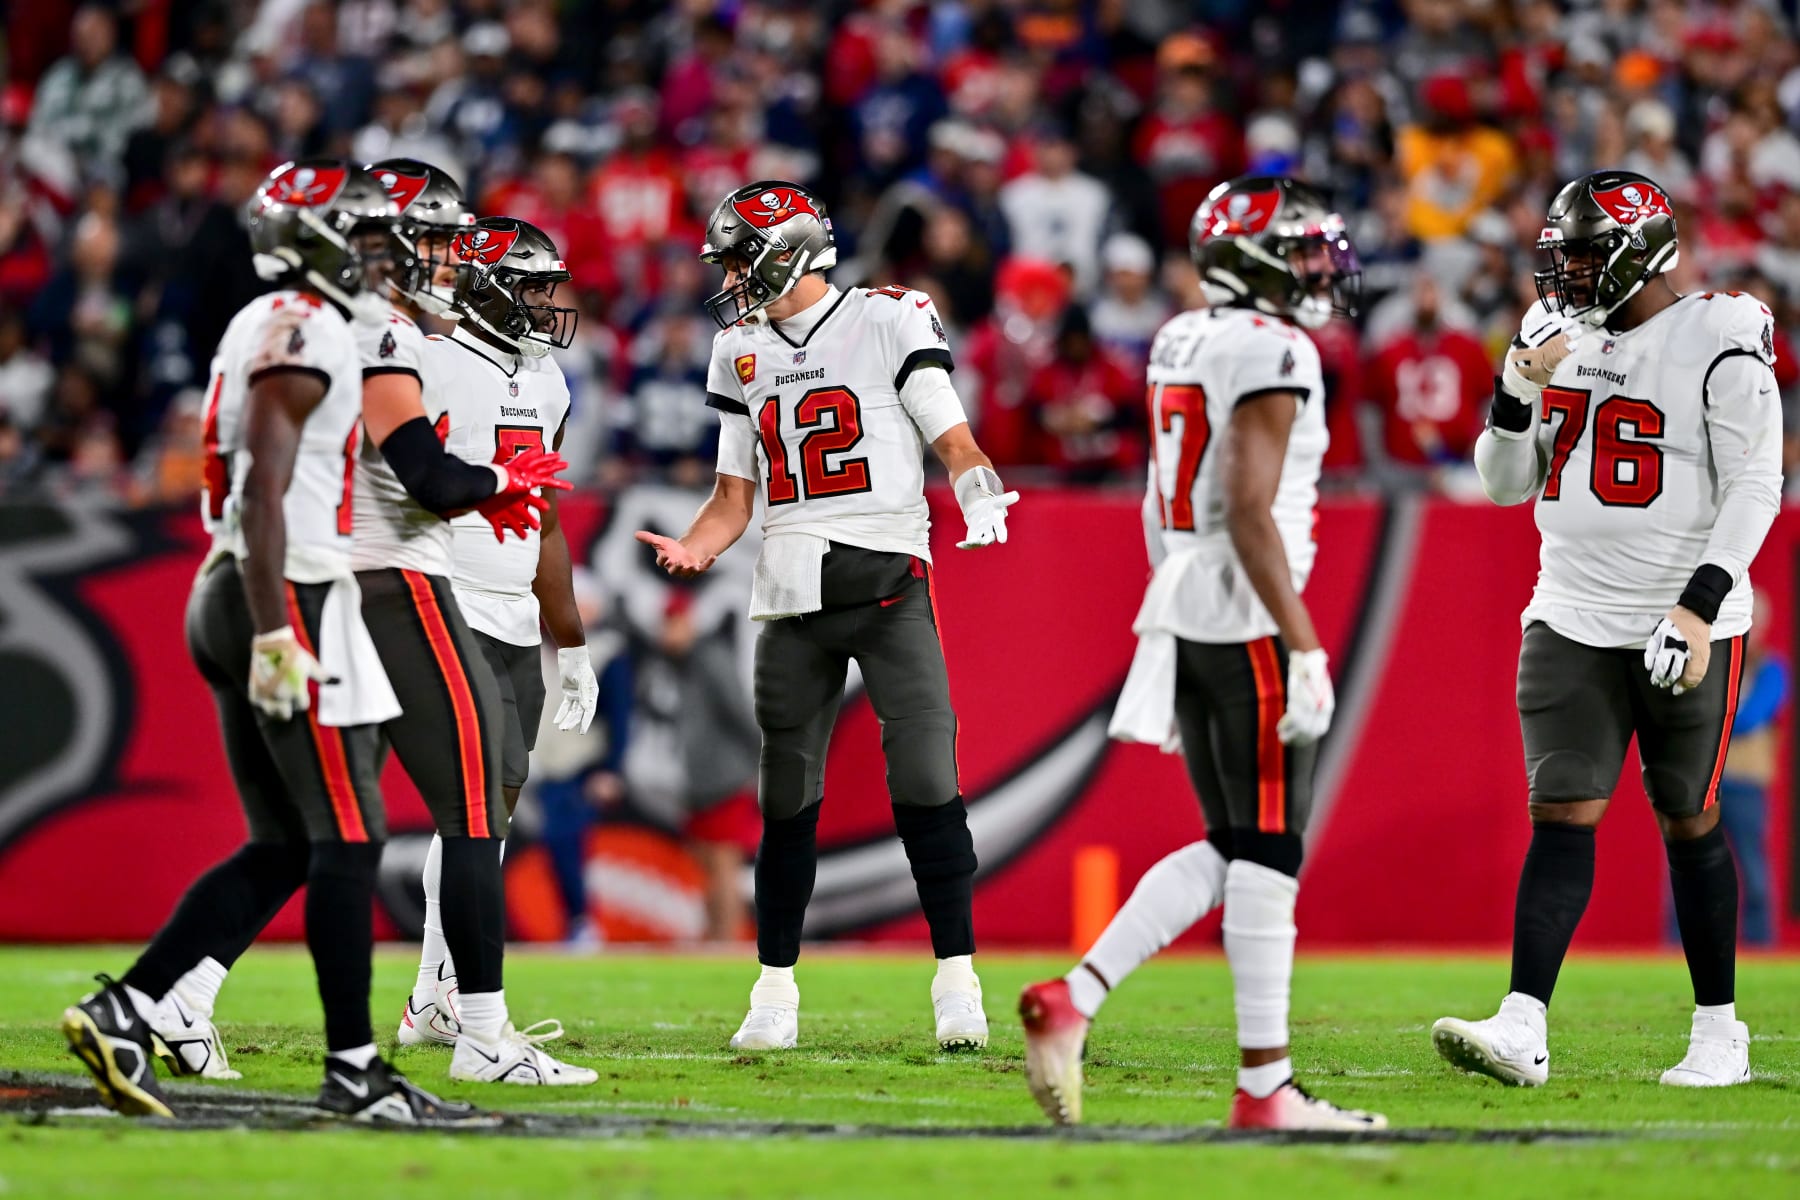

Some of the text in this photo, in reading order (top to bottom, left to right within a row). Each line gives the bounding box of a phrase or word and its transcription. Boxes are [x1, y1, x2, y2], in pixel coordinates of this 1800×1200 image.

[736, 356, 754, 378] C
[758, 384, 873, 507] 12
[1541, 385, 1665, 508] 76
